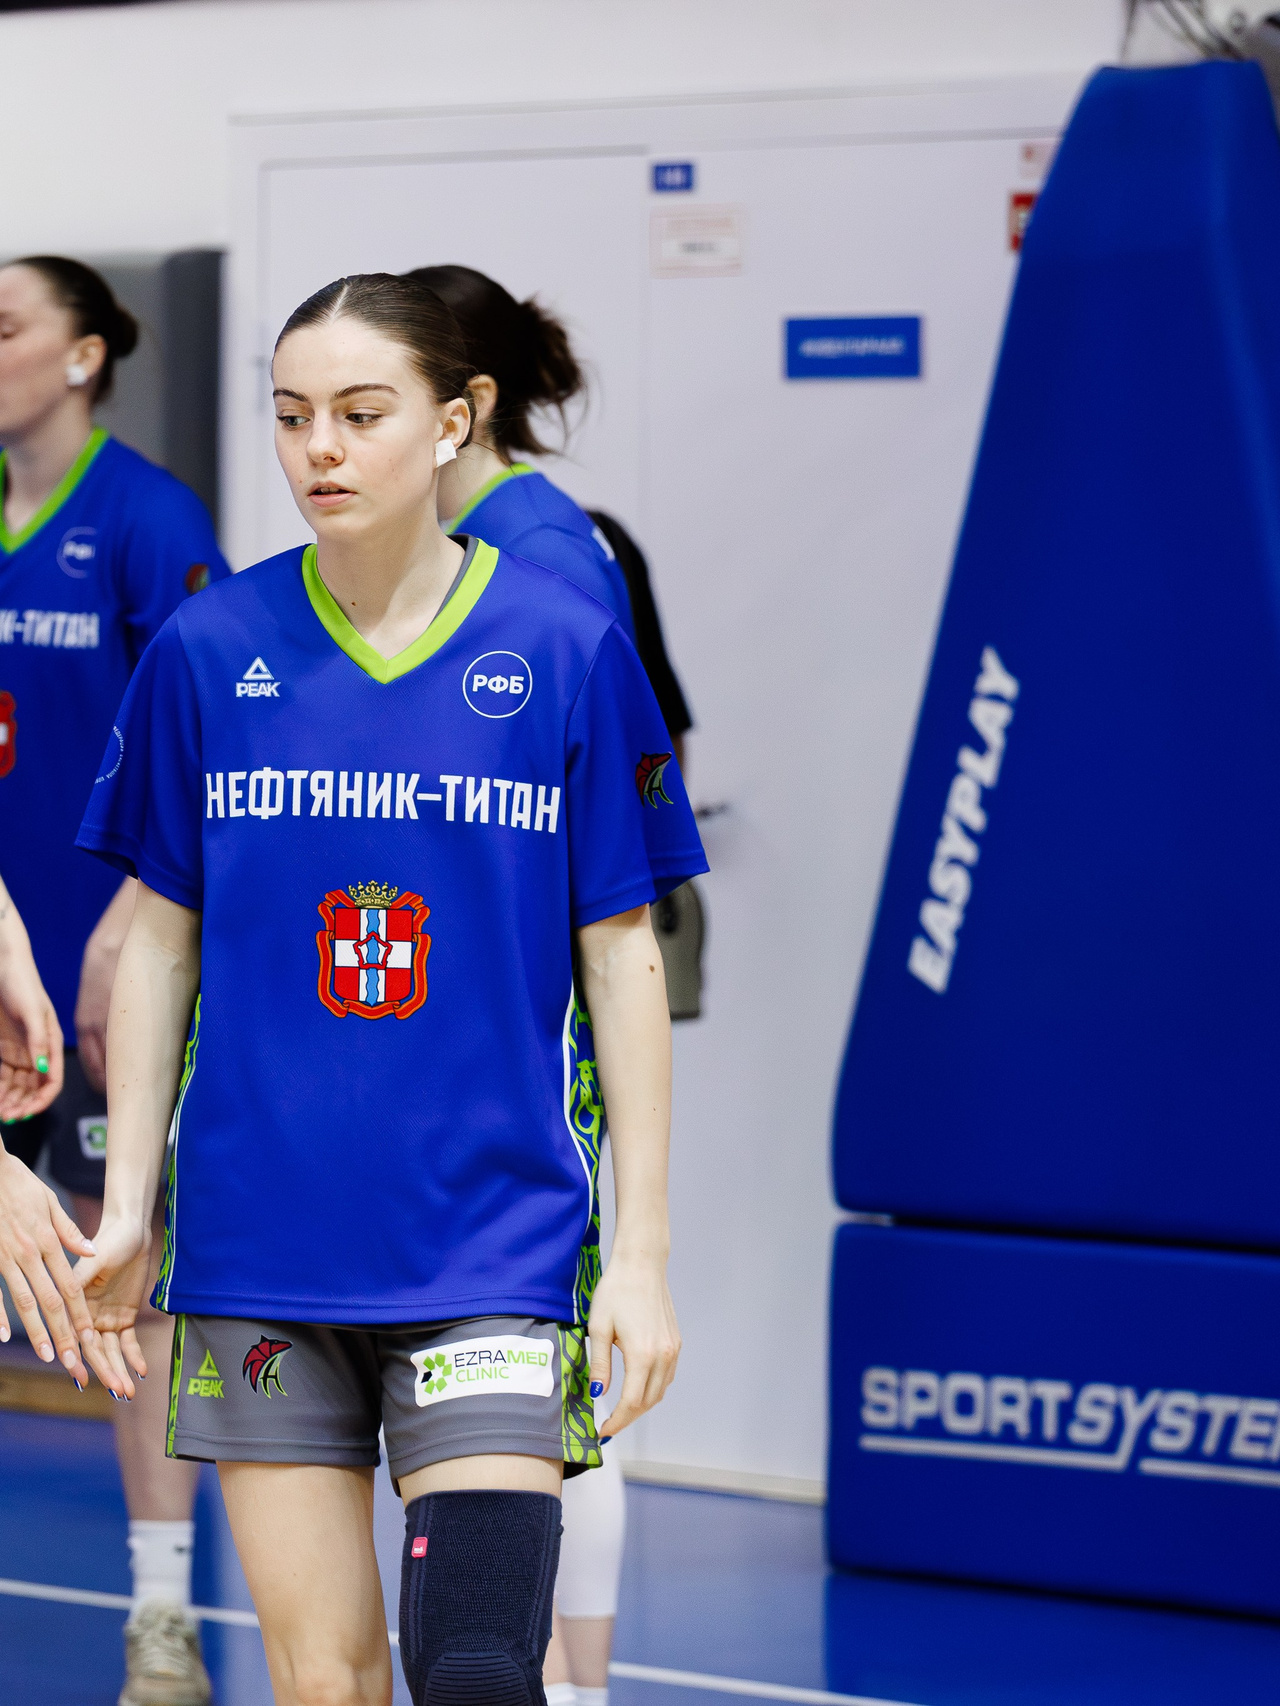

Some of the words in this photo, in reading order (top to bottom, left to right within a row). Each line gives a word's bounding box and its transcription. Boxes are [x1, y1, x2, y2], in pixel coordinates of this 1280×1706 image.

[236, 682, 282, 698] PEAK
[472, 673, 525, 695] РФБ
[206, 767, 561, 834] НЕФТЯНИК-ТИТАН
[907, 645, 1019, 995] EASYPLAY
[454, 1349, 549, 1368] EZRAMED
[455, 1366, 510, 1383] CLINIC
[187, 1377, 225, 1399] PEAK
[861, 1366, 1280, 1472] SPORTSYSTE
